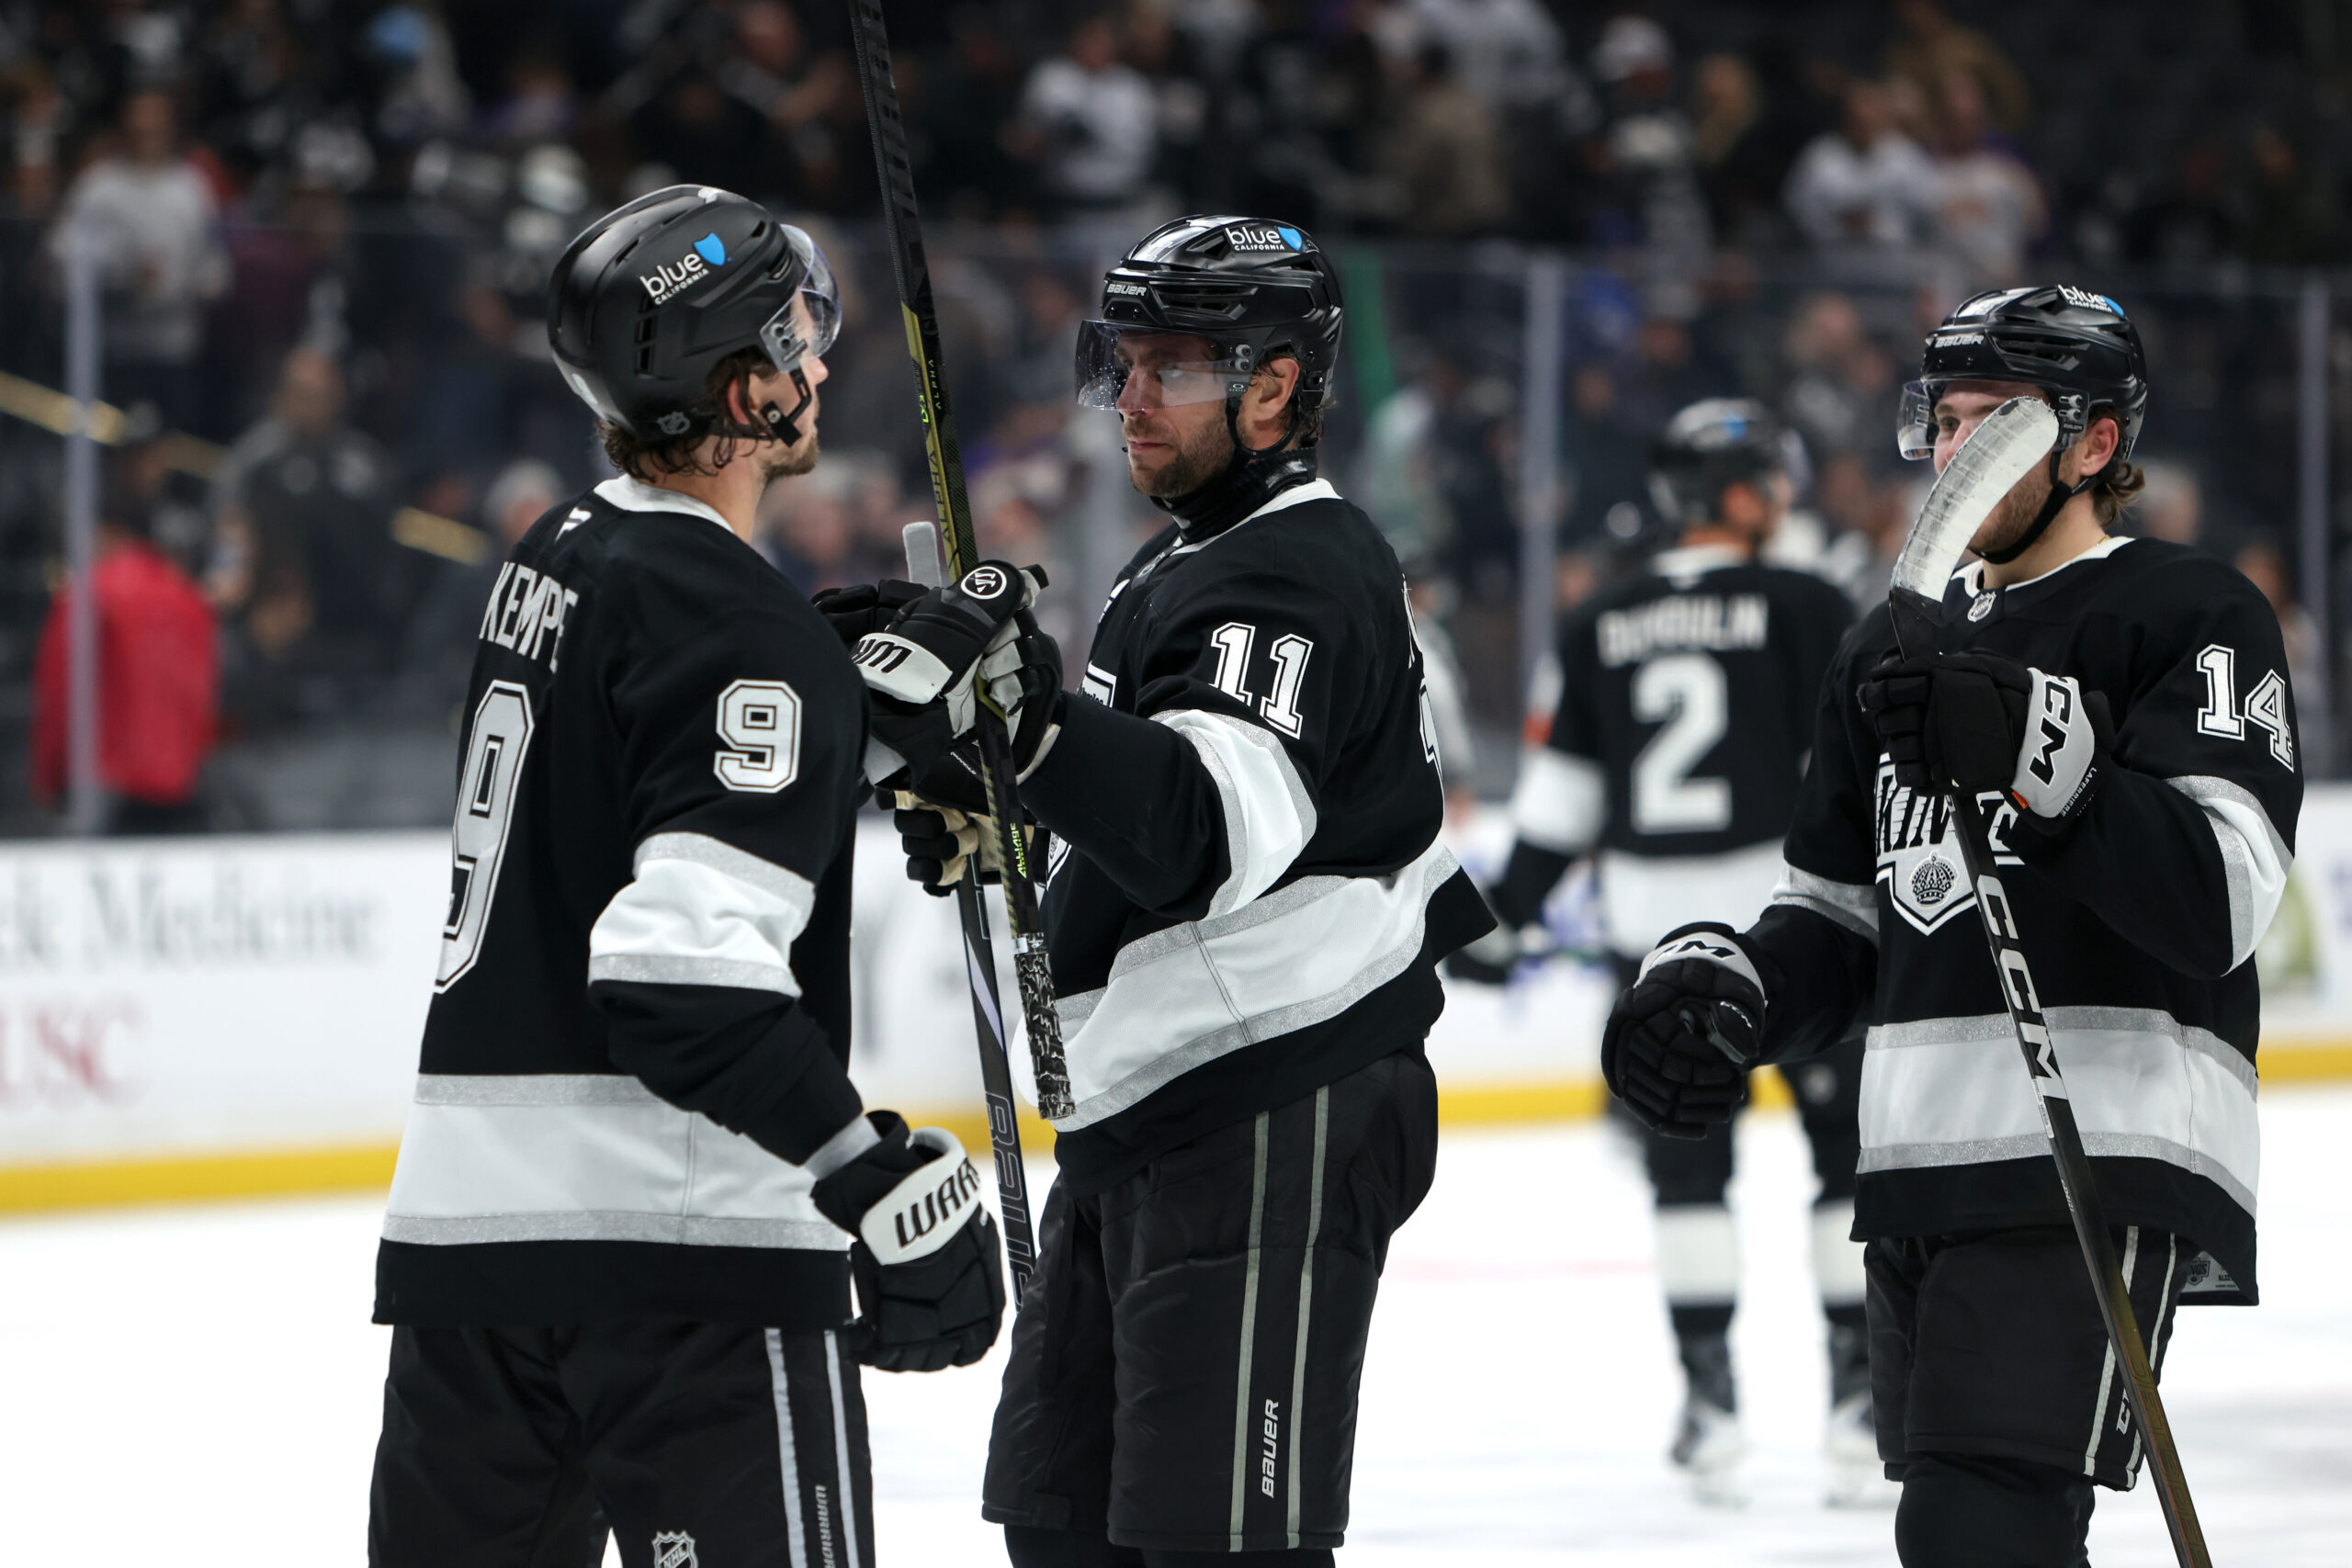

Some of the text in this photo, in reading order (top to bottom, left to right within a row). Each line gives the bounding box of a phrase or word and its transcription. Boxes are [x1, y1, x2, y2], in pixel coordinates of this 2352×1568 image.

[639, 252, 704, 299] blue
[654, 267, 710, 306] CALIFORNIA
[1225, 227, 1281, 244] blue
[2058, 284, 2107, 304] blue
[2069, 299, 2112, 312] CALIFORNIA
[1208, 622, 1314, 740] 11
[2029, 676, 2075, 787] CM
[2196, 644, 2294, 773] 14
[714, 679, 802, 794] 9
[1631, 651, 1732, 834] 2
[434, 679, 535, 994] 9
[1976, 874, 2070, 1102] CCM
[895, 1156, 981, 1248] WAR
[1261, 1398, 1279, 1498] BAUER
